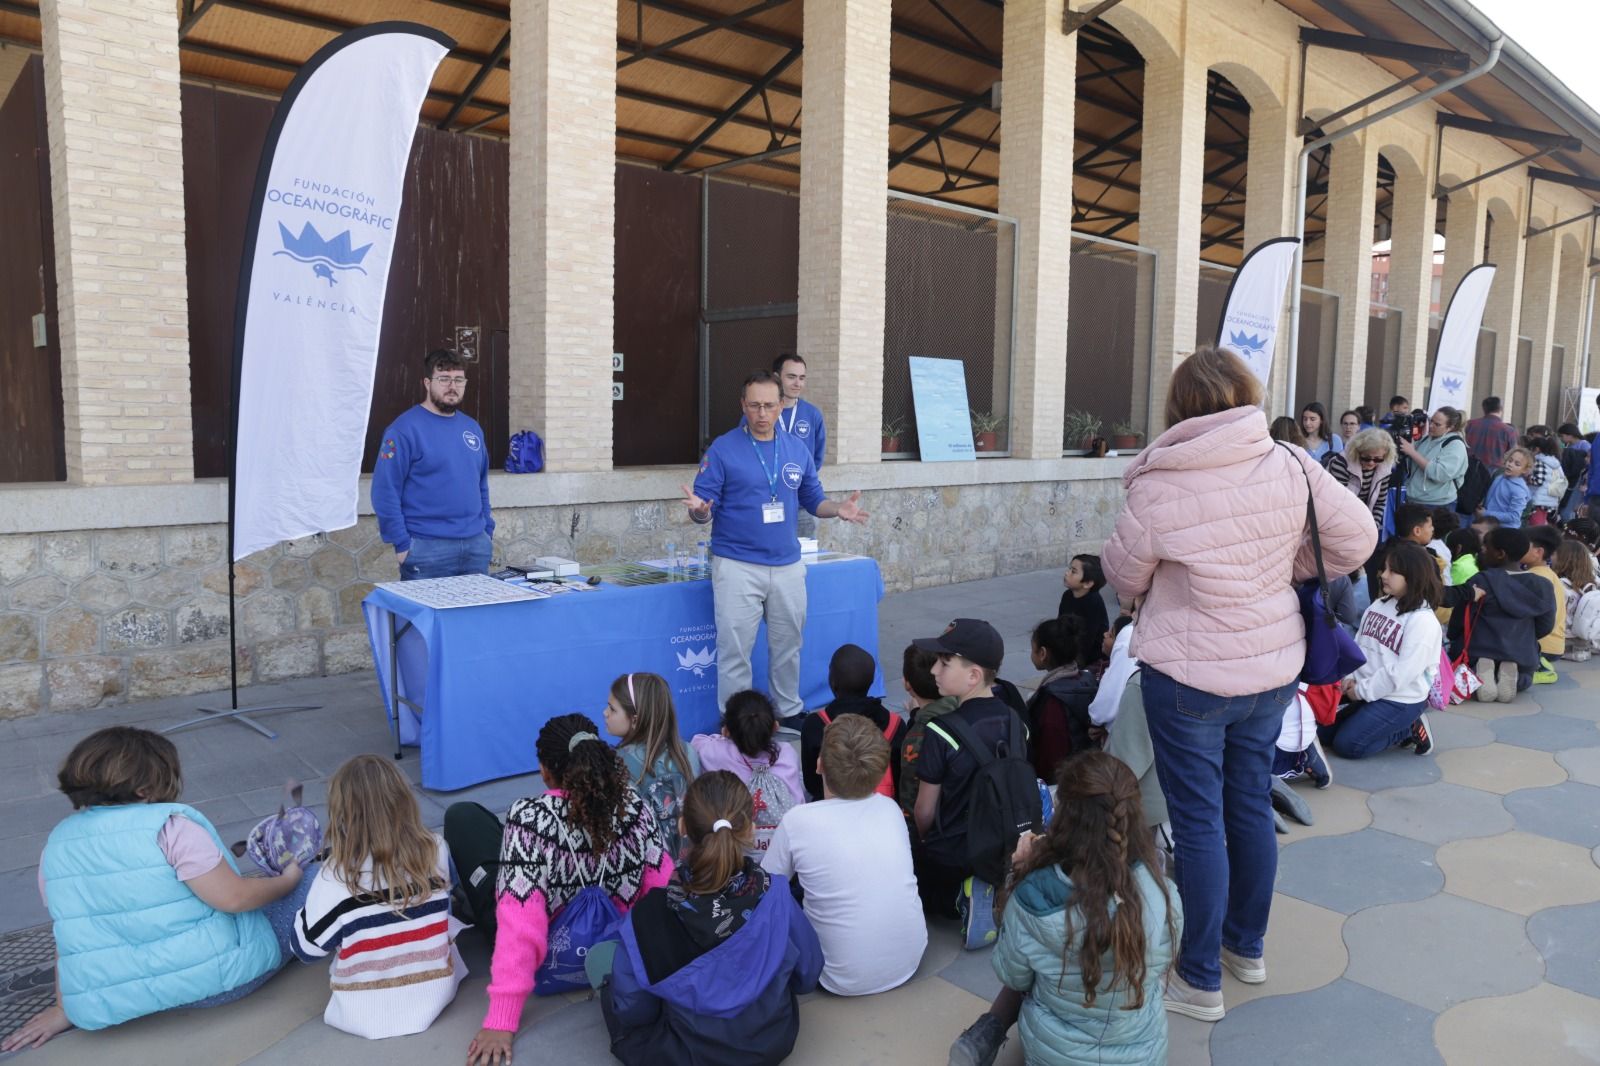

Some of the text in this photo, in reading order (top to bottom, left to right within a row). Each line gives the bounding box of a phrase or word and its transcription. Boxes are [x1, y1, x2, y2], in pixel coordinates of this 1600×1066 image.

[293, 177, 376, 207] FUNDACIÓN
[267, 188, 393, 231] OCEANOGRÀFIC
[272, 291, 357, 315] VALÈNCIA
